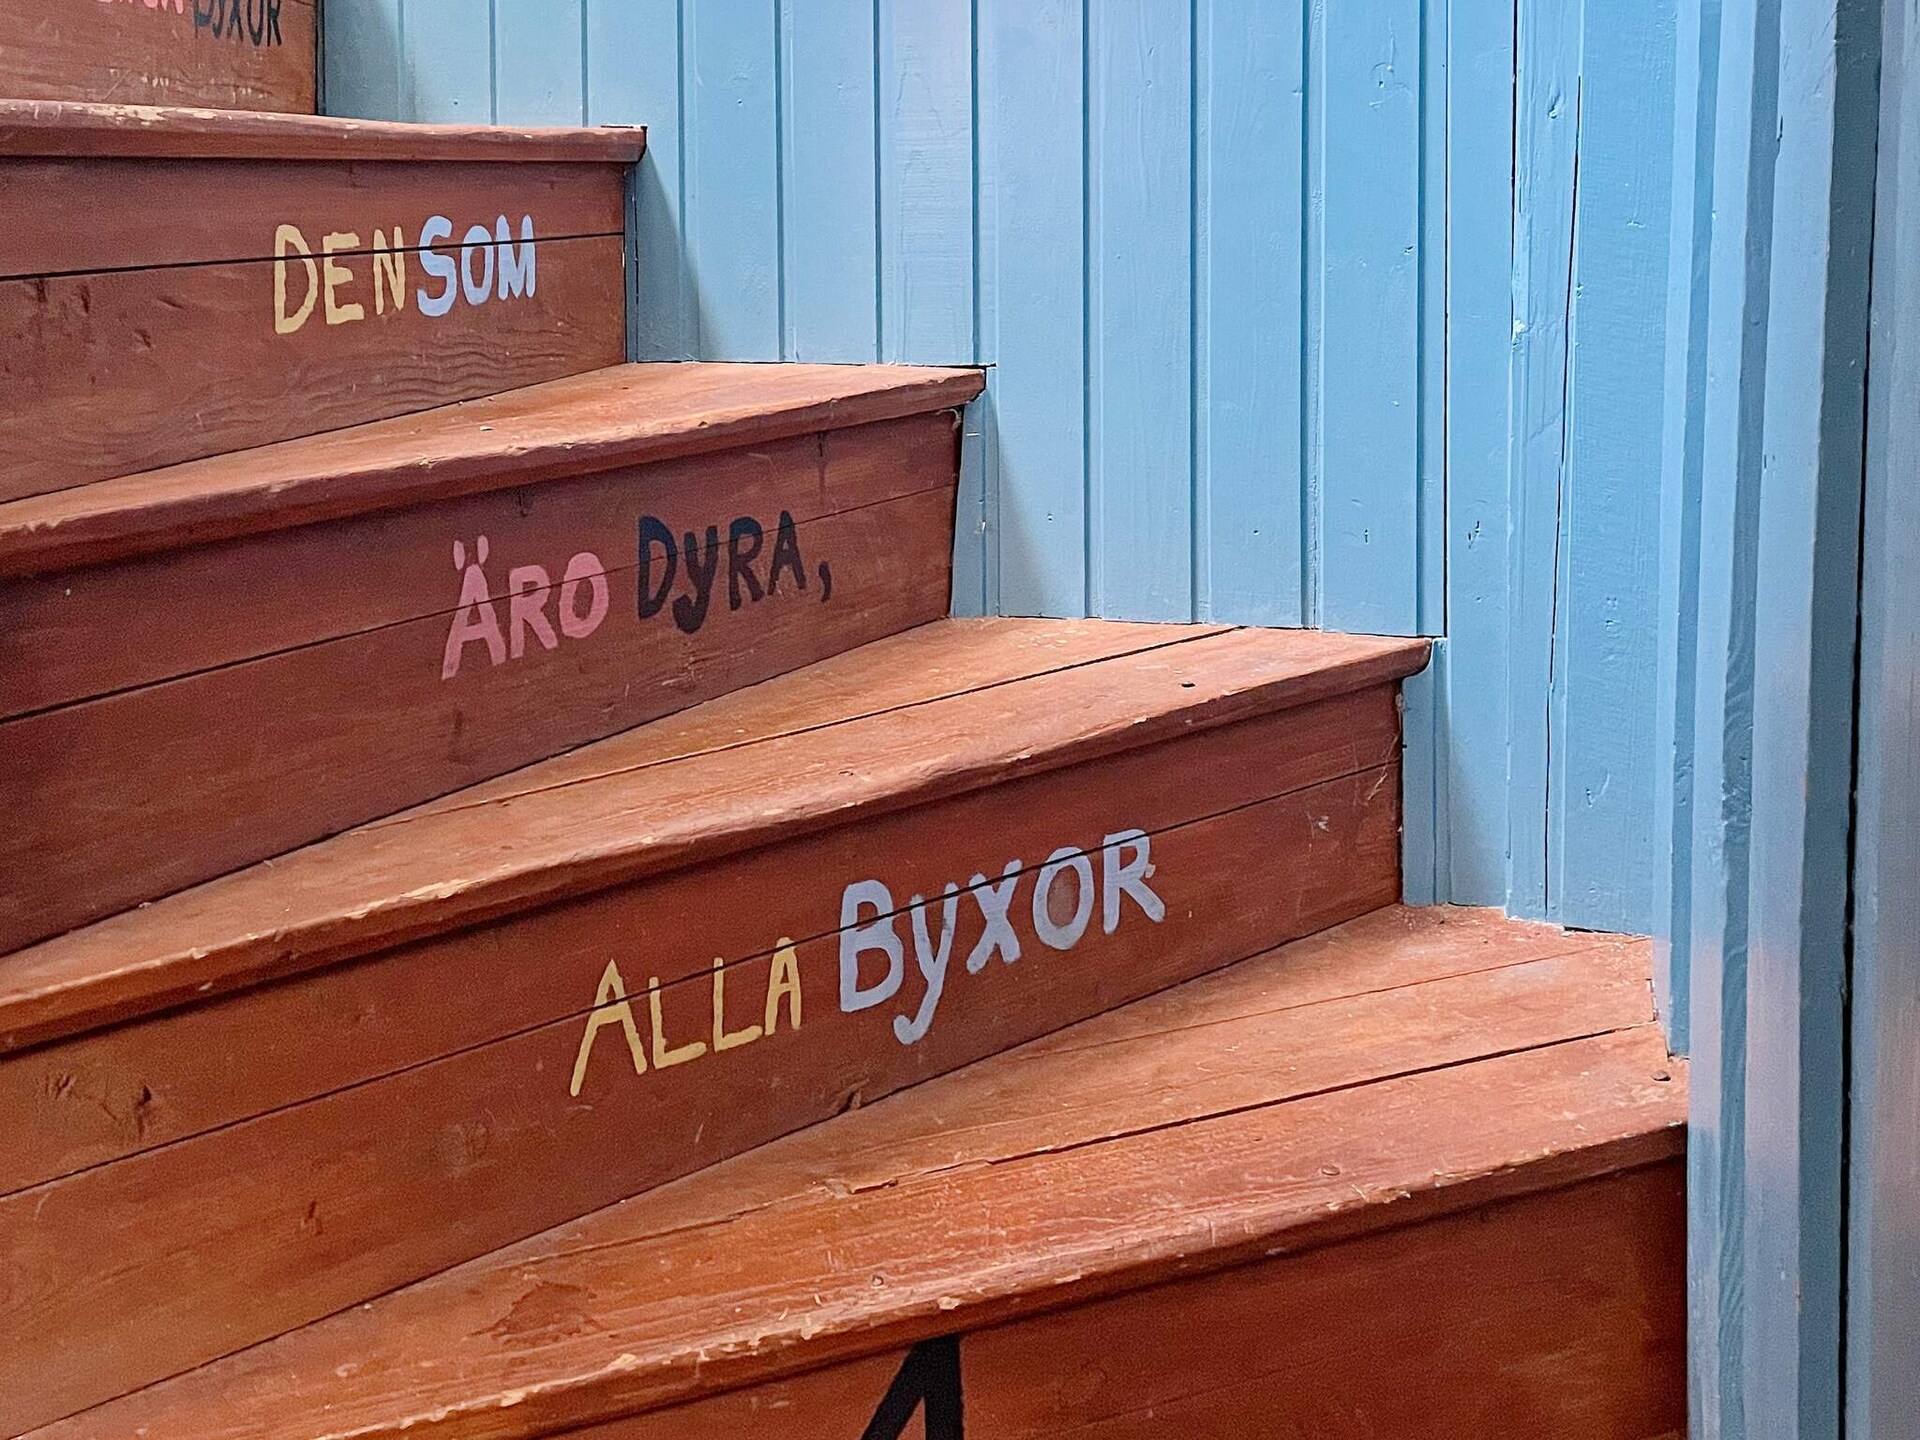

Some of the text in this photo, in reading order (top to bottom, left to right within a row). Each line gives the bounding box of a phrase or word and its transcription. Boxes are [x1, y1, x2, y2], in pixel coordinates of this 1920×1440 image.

[274, 214, 536, 335] DEN SOM
[441, 535, 609, 680] ÄRO
[569, 936, 801, 1098] ALLA
